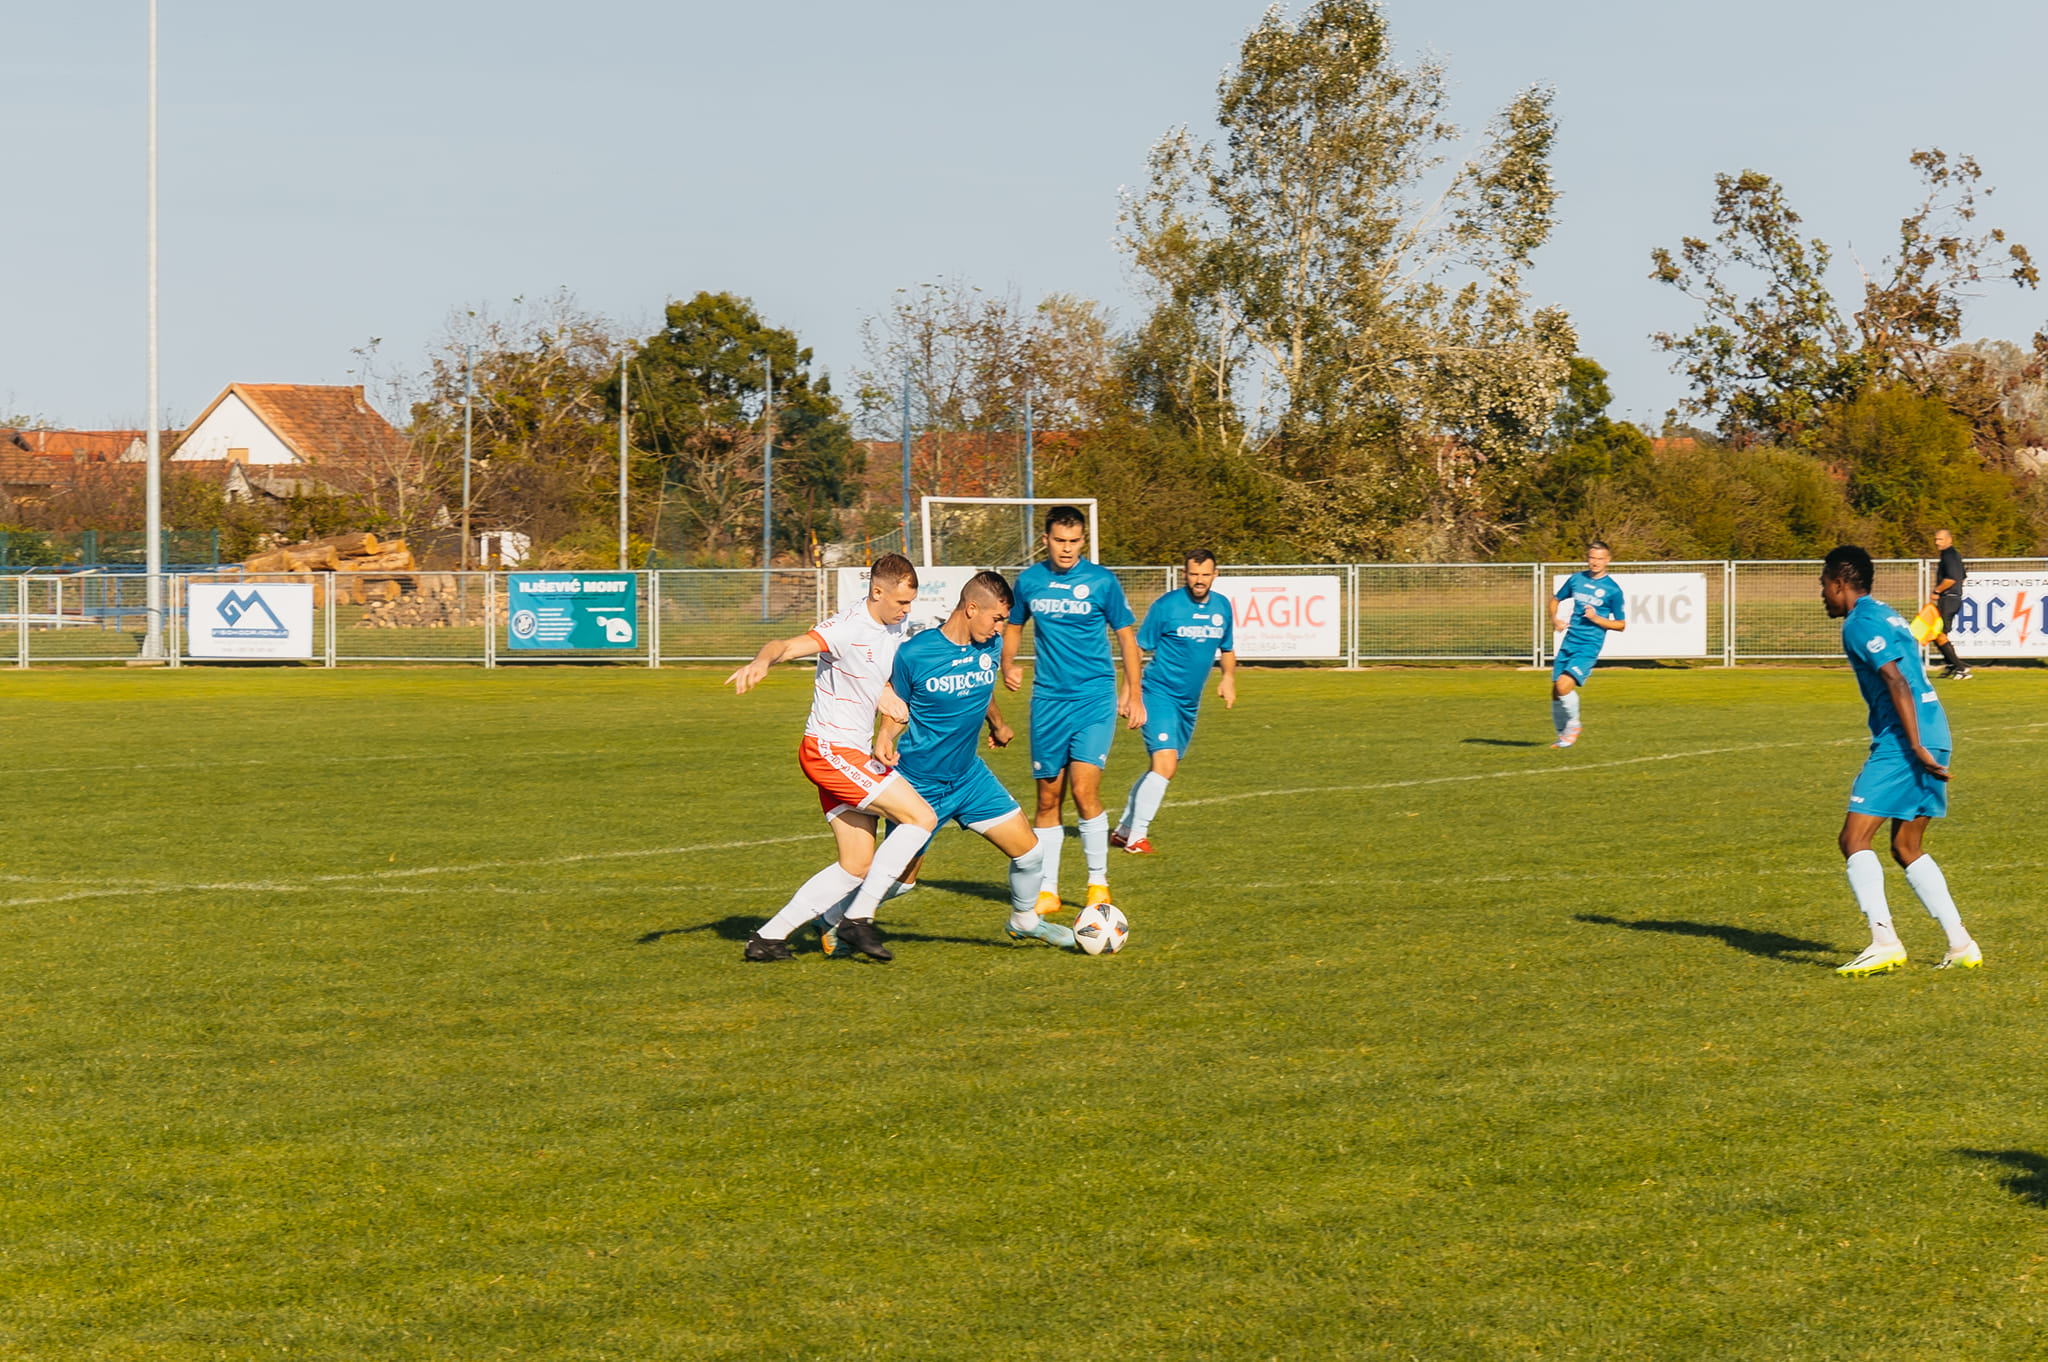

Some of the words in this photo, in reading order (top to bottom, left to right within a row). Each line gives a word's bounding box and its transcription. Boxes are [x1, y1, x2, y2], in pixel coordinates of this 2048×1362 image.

[519, 579, 581, 593] ILIŠEVIĆ
[583, 581, 627, 593] MONT
[1030, 598, 1092, 615] OSJEČKO
[1630, 585, 1693, 625] KIĆ
[925, 669, 994, 695] OSJEČKO
